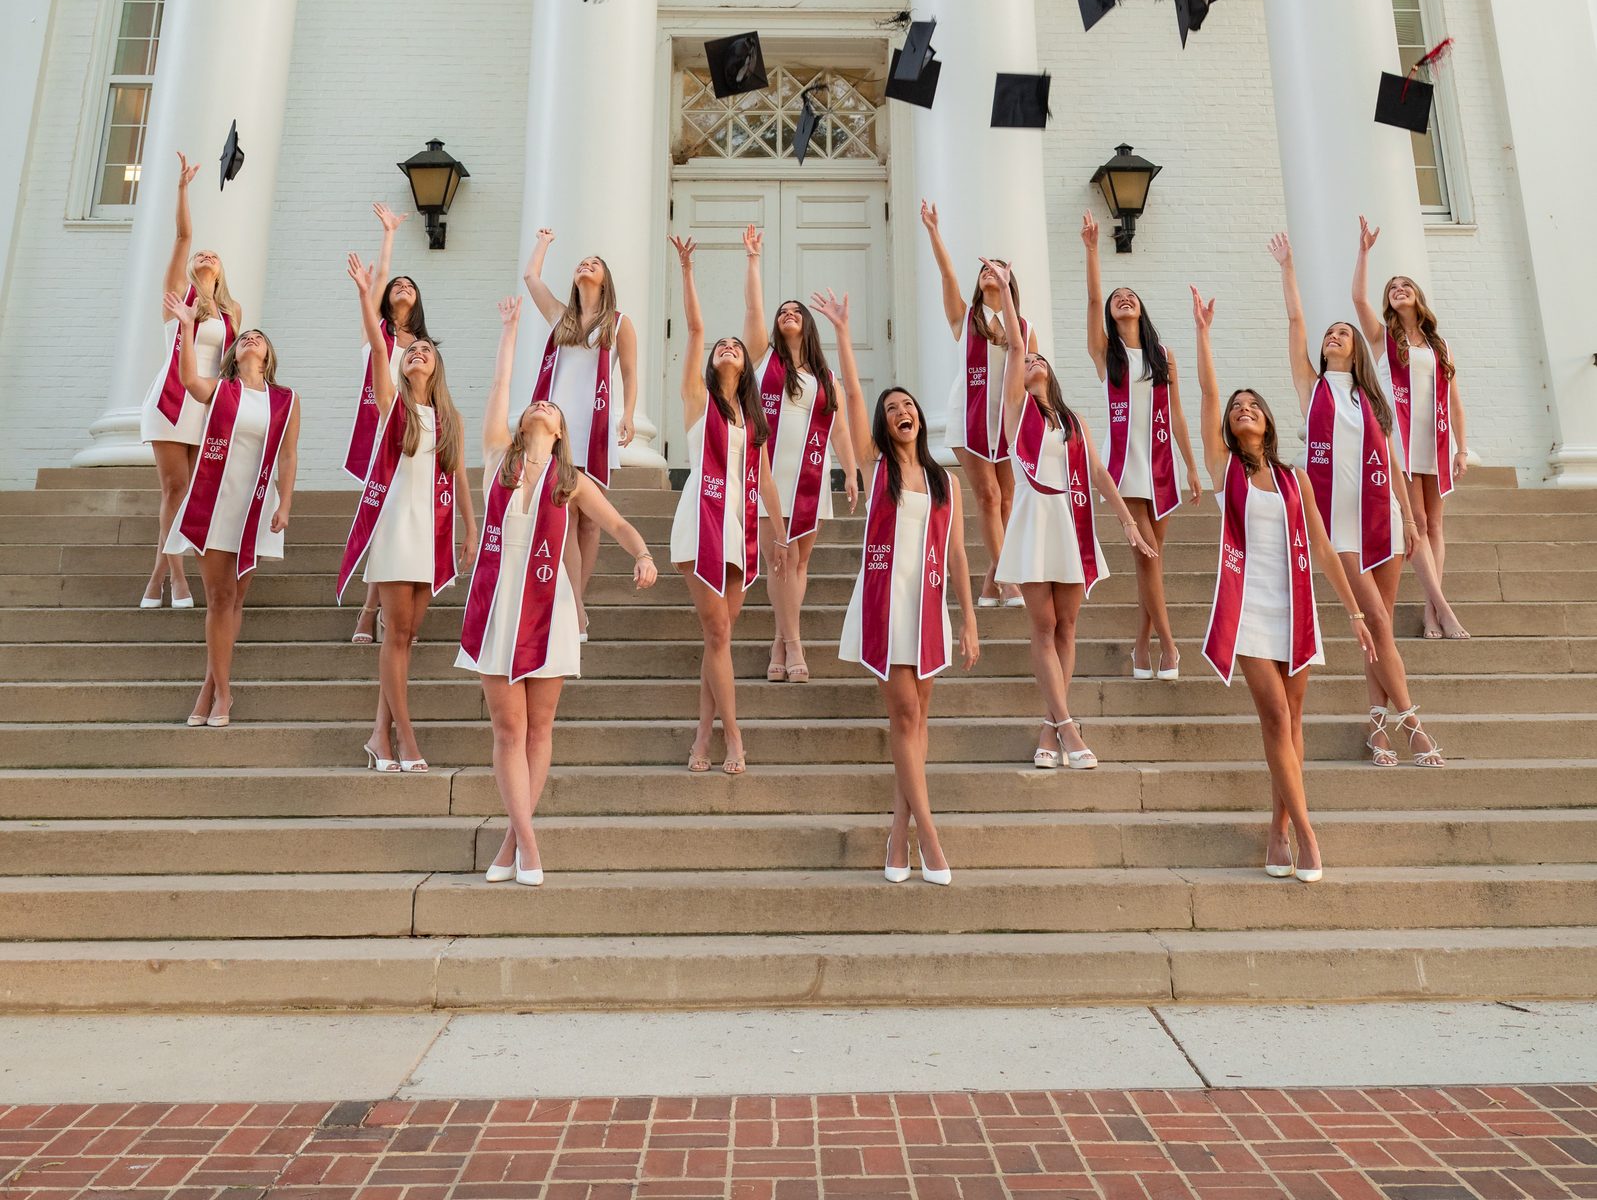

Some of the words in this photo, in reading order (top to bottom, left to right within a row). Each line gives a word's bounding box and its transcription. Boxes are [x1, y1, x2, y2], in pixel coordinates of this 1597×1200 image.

[762, 393, 780, 401] CLASS
[207, 438, 227, 446] CLASS
[1311, 442, 1331, 450] CLASS
[704, 475, 724, 485] CLASS
[369, 481, 386, 492] CLASS
[370, 490, 378, 498] OF
[705, 490, 721, 499] 2026
[363, 497, 379, 507] 2026
[485, 543, 500, 552] 2026
[1225, 544, 1243, 559] CLASS
[1229, 554, 1238, 563] OF
[1225, 560, 1240, 574] 2026
